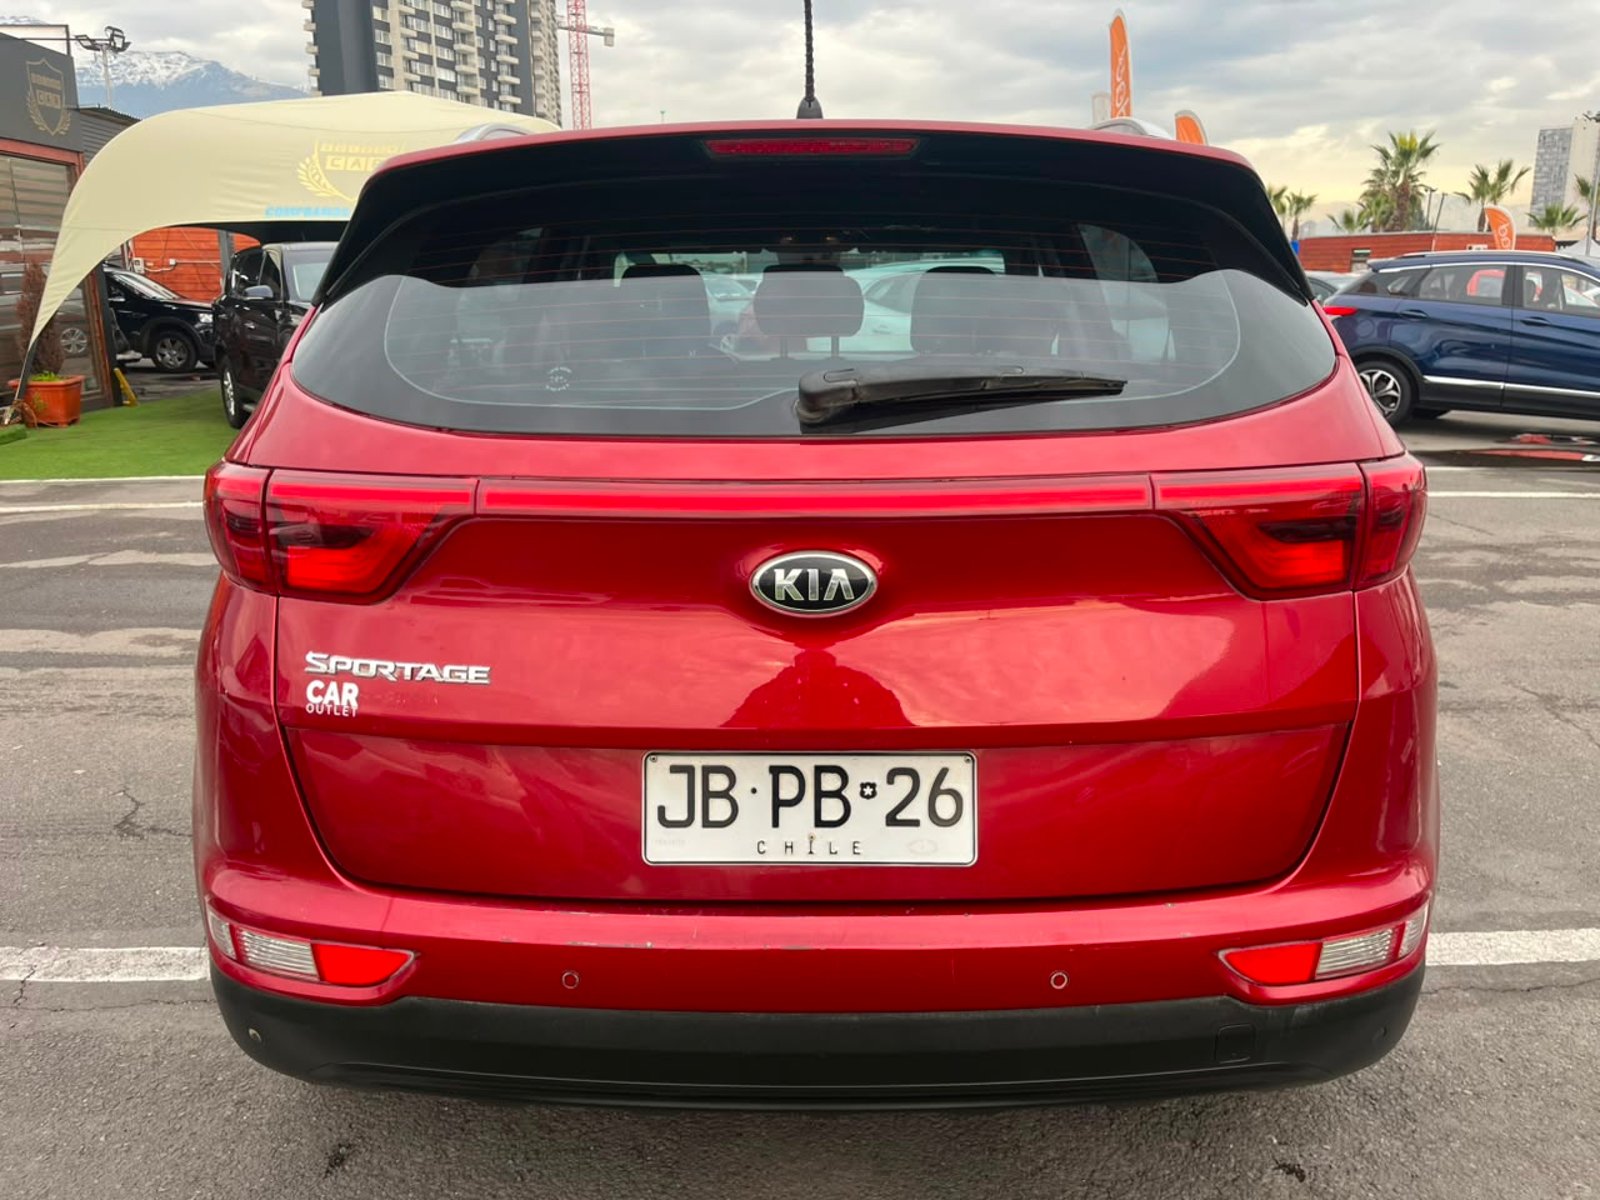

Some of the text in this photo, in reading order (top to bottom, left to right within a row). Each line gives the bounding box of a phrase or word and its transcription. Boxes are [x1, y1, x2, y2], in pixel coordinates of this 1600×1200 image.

[774, 568, 854, 601] KIA
[305, 651, 490, 684] SPORTAGE
[306, 680, 359, 708] CAR
[306, 703, 358, 717] OUTLET
[757, 841, 861, 855] CHILE
